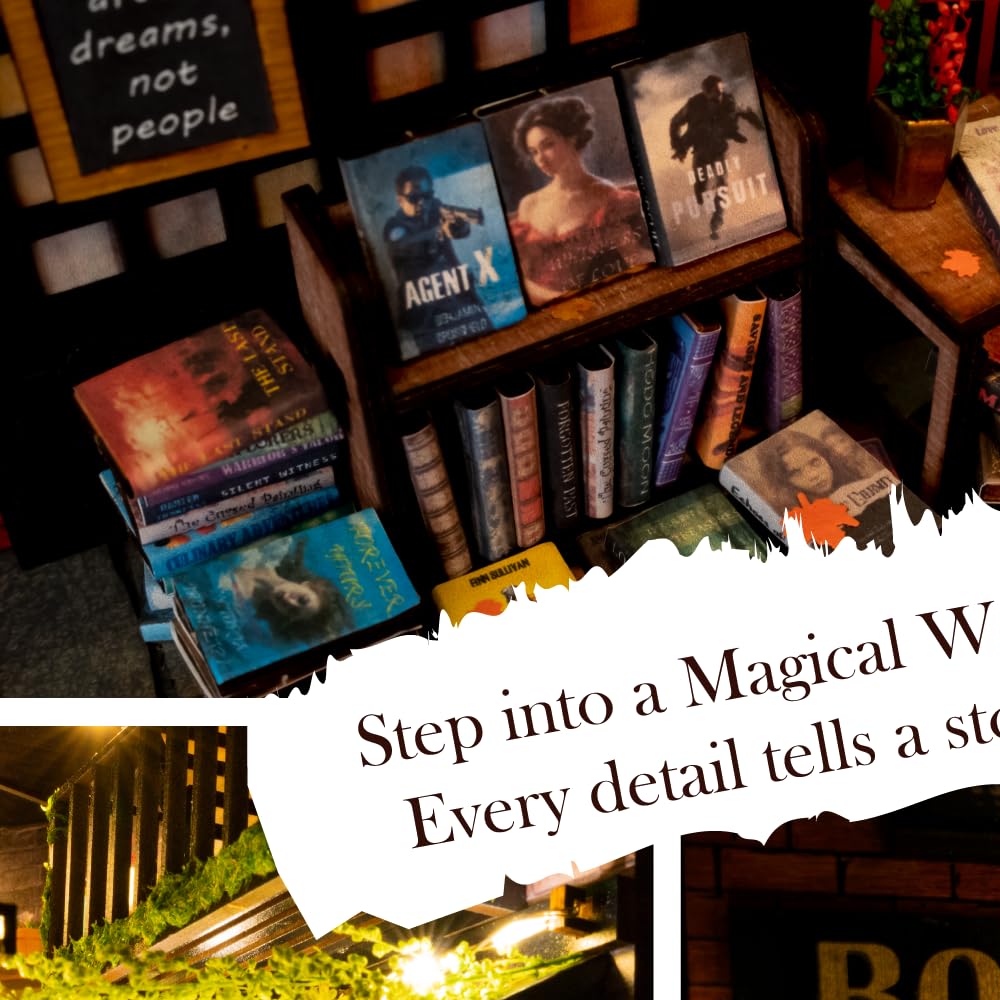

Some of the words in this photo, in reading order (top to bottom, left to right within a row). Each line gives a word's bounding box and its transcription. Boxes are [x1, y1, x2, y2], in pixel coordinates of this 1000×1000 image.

[69, 13, 231, 66] dreams,
[129, 60, 198, 97] not
[112, 94, 239, 155] people
[687, 156, 742, 186] DEADLY
[671, 172, 769, 226] PURSUIT
[404, 263, 470, 310] AGENT
[473, 246, 501, 288] X
[277, 452, 338, 478] WITNESS
[557, 400, 577, 485] FORGOTTEN
